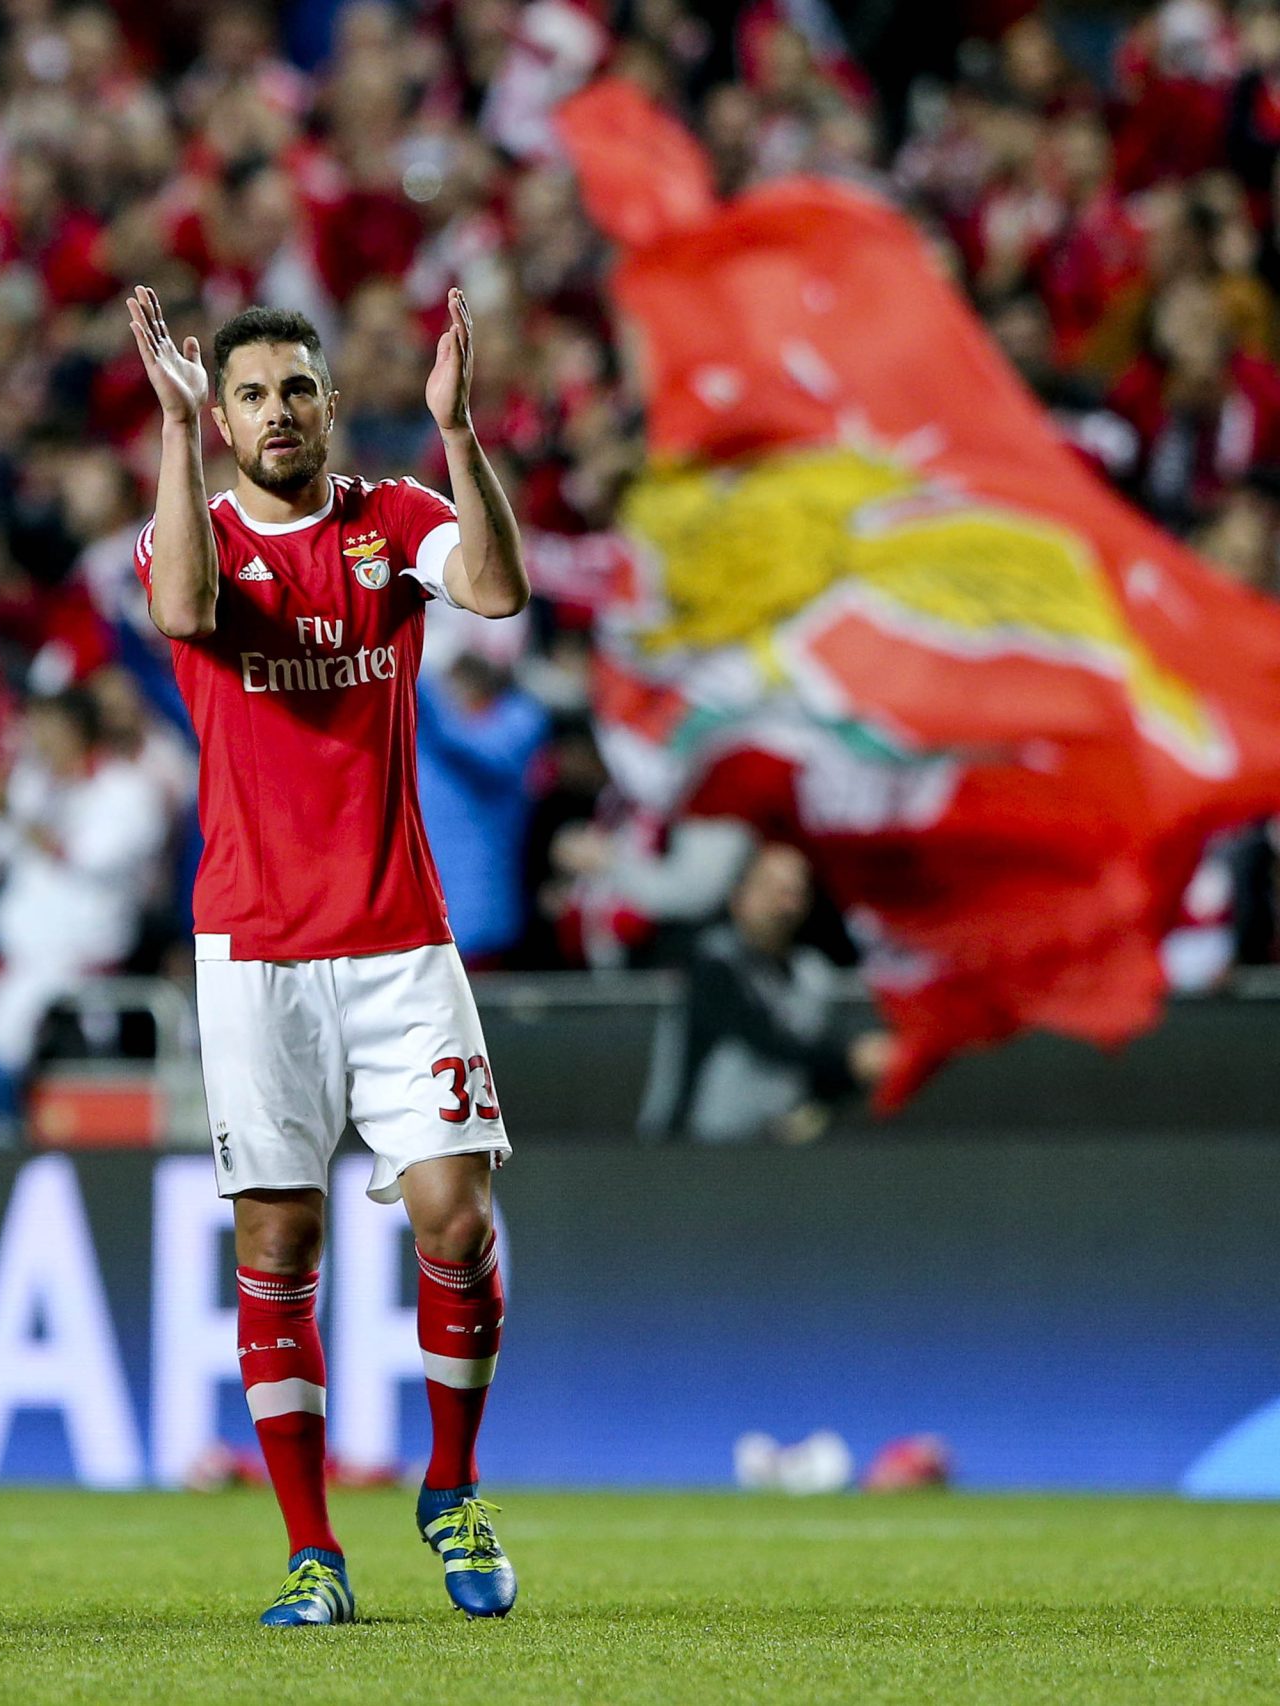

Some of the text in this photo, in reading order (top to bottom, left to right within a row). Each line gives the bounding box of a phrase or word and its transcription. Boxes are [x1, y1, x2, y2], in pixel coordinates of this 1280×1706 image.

[296, 616, 343, 649] Fly
[240, 645, 396, 693] Emirates
[431, 1055, 500, 1123] 33
